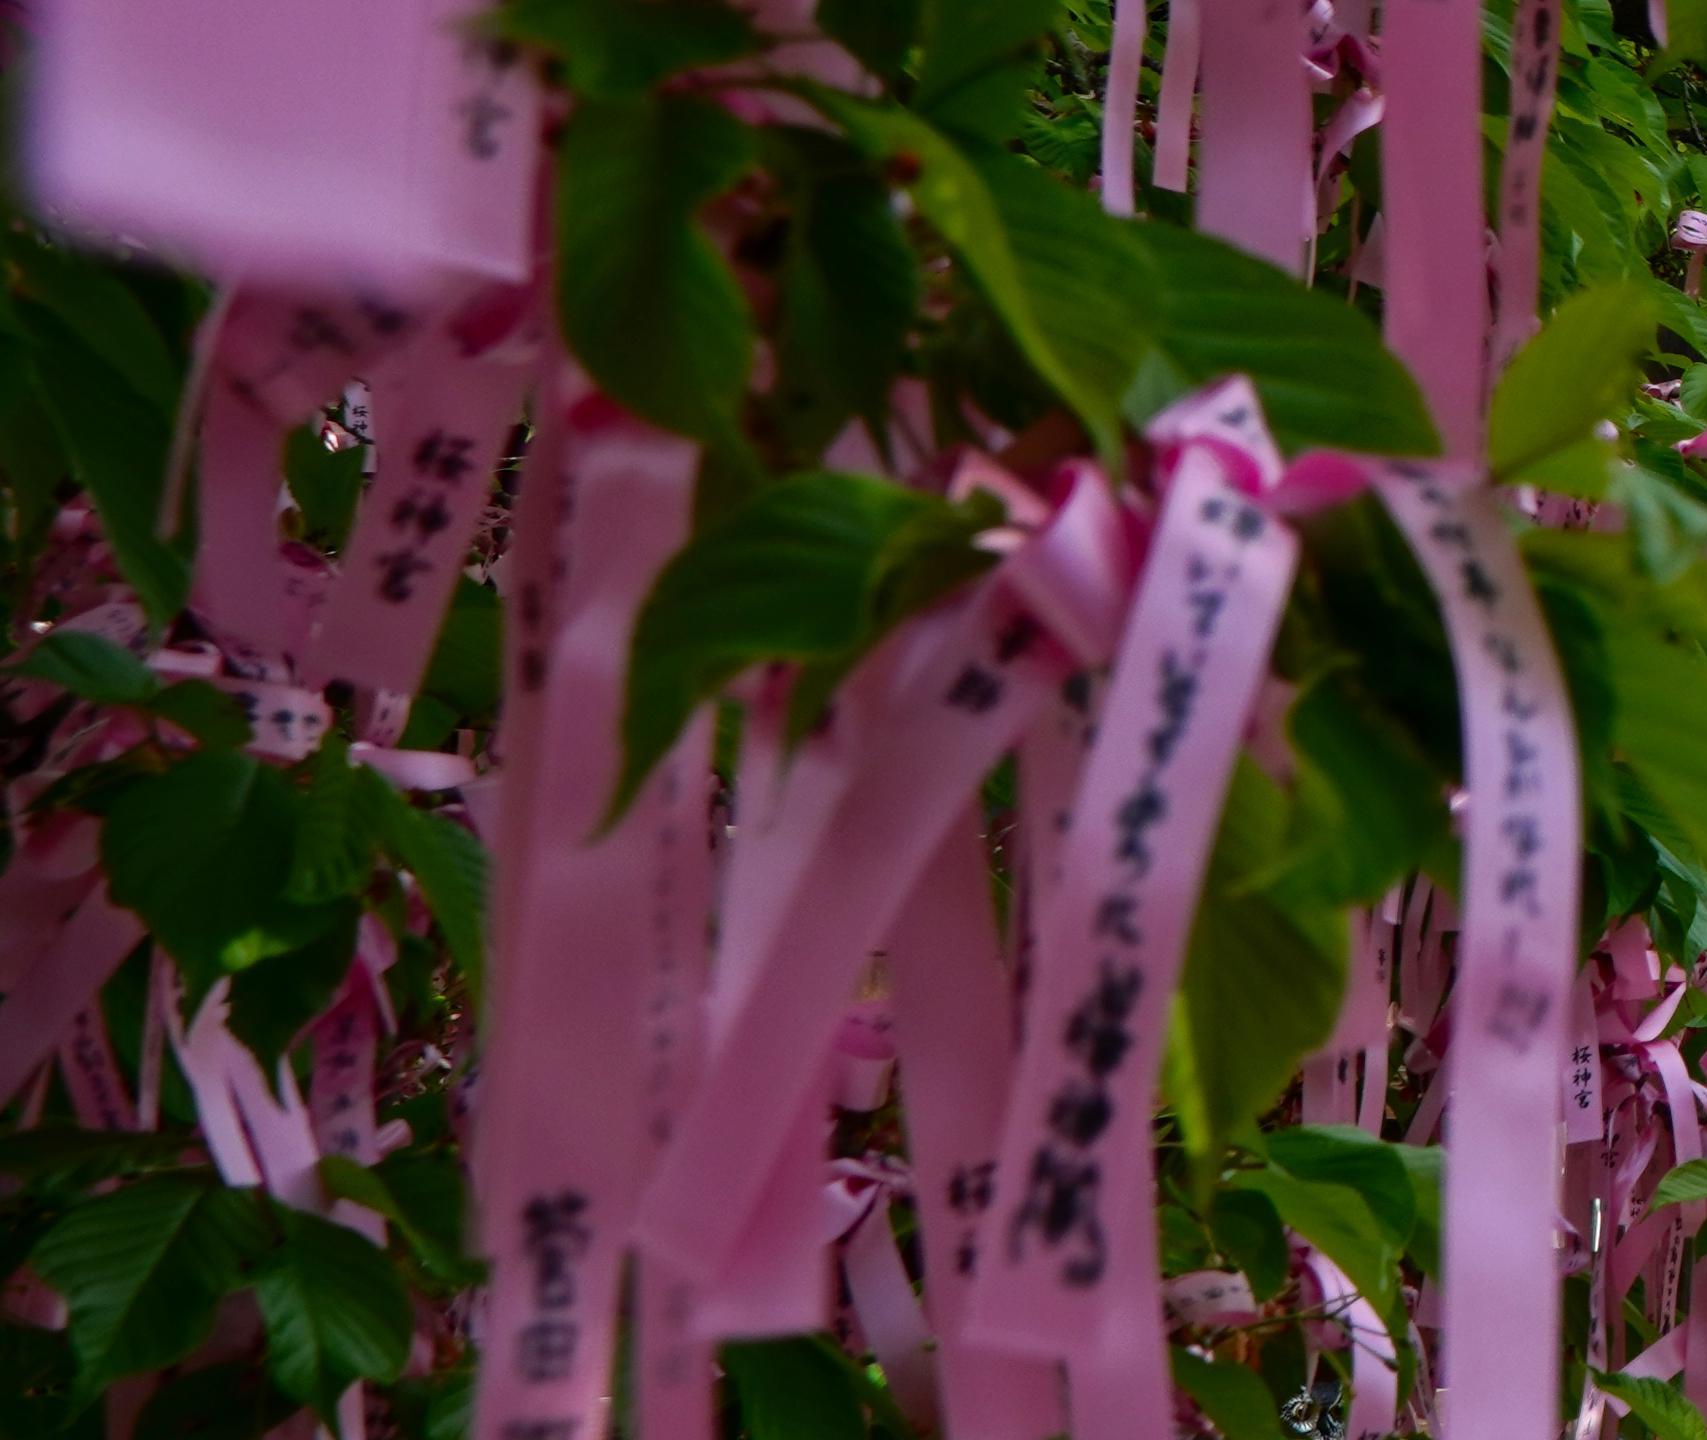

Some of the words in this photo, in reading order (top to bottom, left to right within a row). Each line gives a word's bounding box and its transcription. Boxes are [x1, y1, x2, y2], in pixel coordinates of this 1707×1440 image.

[378, 428, 477, 605] 桜神宮
[1571, 1046, 1593, 1109] 桜神宮
